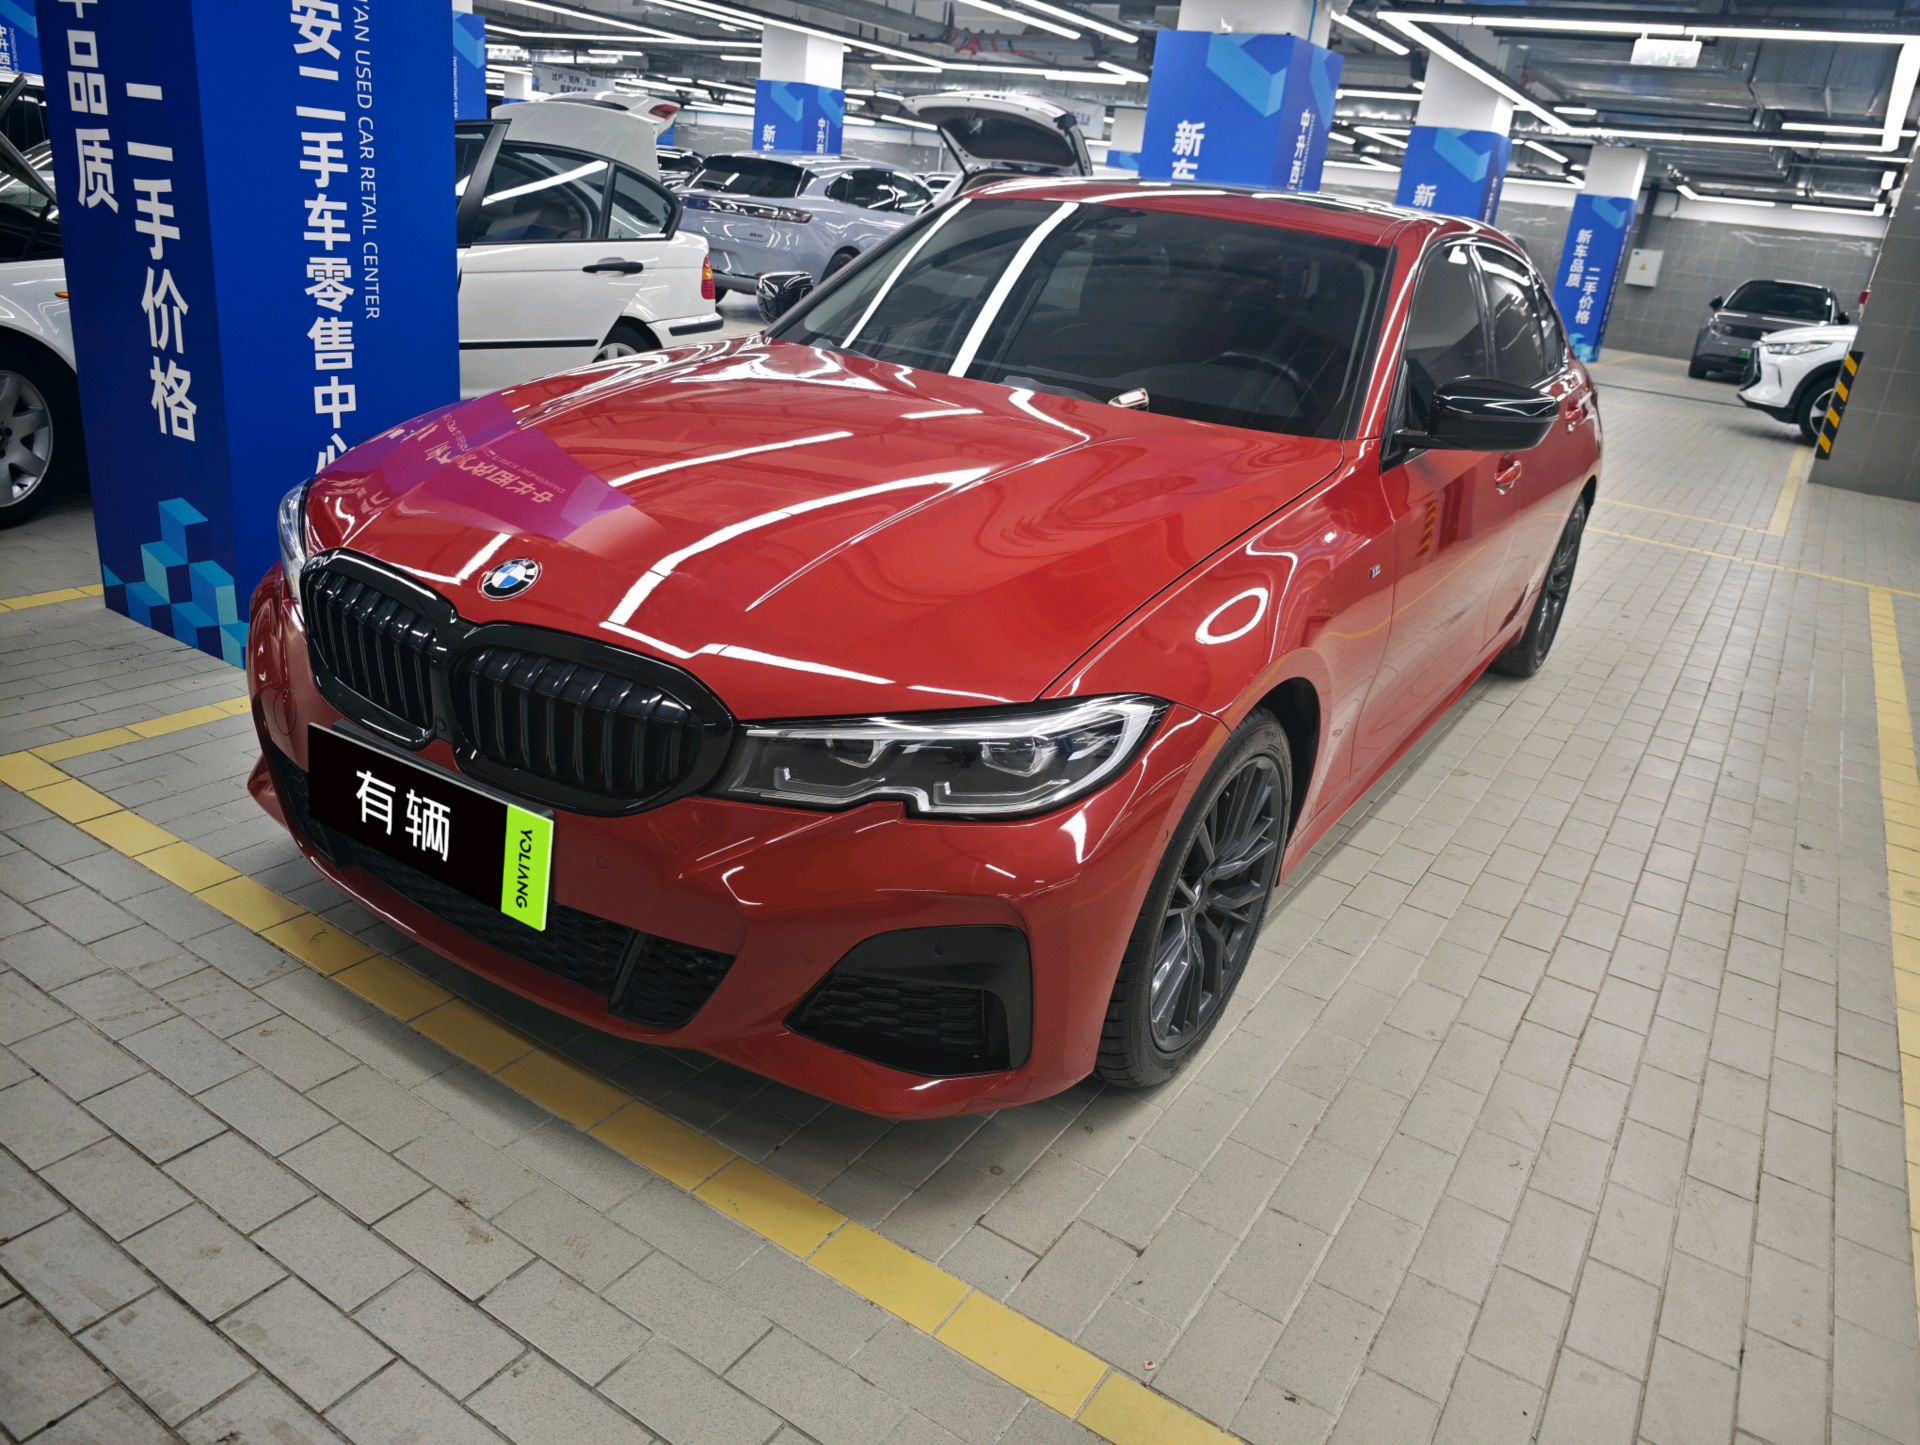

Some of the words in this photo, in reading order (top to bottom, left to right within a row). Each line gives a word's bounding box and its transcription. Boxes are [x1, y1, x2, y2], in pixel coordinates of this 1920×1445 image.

[353, 0, 371, 42] 'AN
[355, 50, 374, 109] USED
[357, 116, 376, 159] CAR
[1289, 109, 1311, 189] 中升西
[360, 166, 378, 235] RETAIL
[1412, 184, 1437, 207] 新
[126, 82, 197, 442] 二手价格
[363, 242, 381, 319] CENTER
[1565, 229, 1593, 287] 新车品质
[1575, 267, 1600, 324] 二手价格
